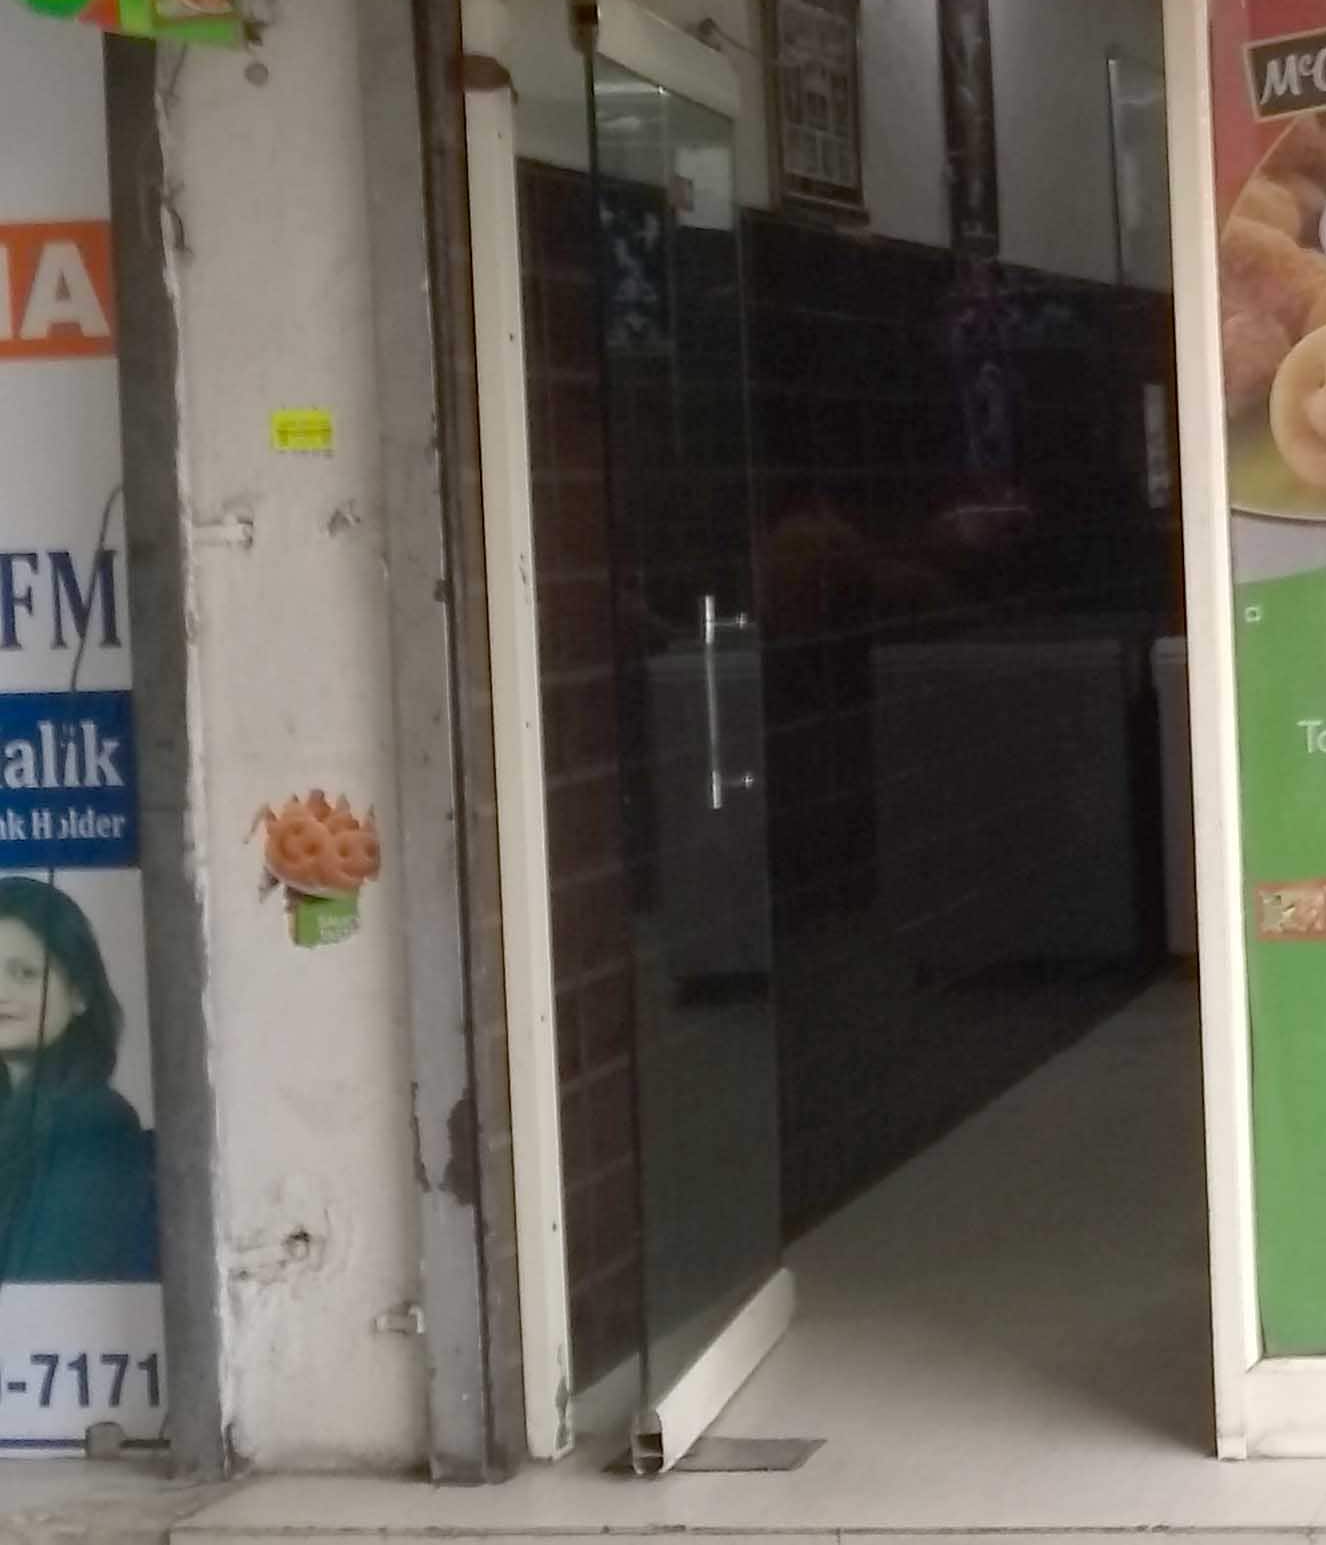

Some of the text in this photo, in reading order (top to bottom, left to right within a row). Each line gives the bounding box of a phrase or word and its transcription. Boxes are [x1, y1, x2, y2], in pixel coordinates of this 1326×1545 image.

[0, 551, 122, 649] FM
[0, 719, 125, 788] alik
[0, 1352, 160, 1408] -7171
